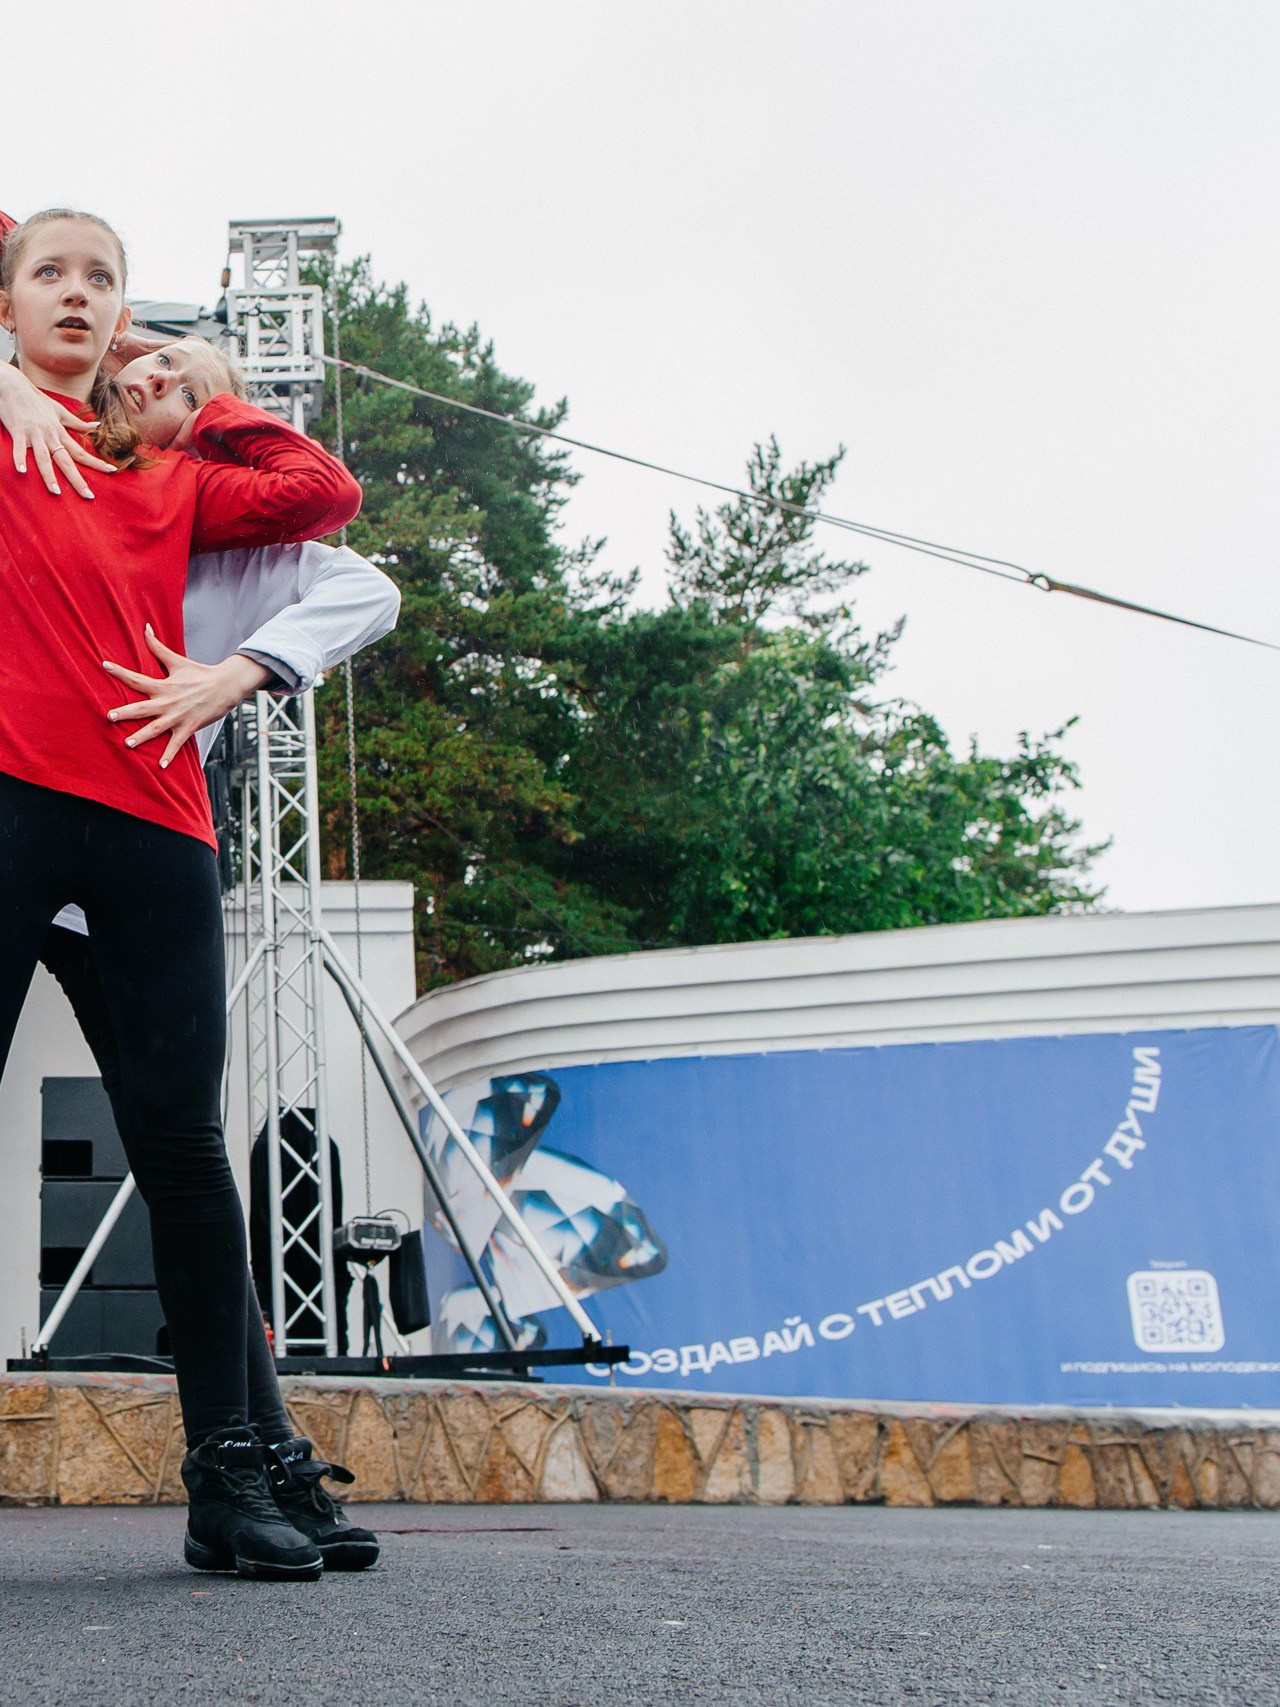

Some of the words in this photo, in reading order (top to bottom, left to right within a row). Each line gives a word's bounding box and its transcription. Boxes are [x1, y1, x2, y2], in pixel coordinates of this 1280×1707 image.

[818, 1312, 855, 1340] С
[856, 1229, 1034, 1327] ТЕПЛОМ
[1026, 1208, 1065, 1243] И
[1059, 1158, 1112, 1215] ОТ
[1103, 1046, 1162, 1170] ДУШИ
